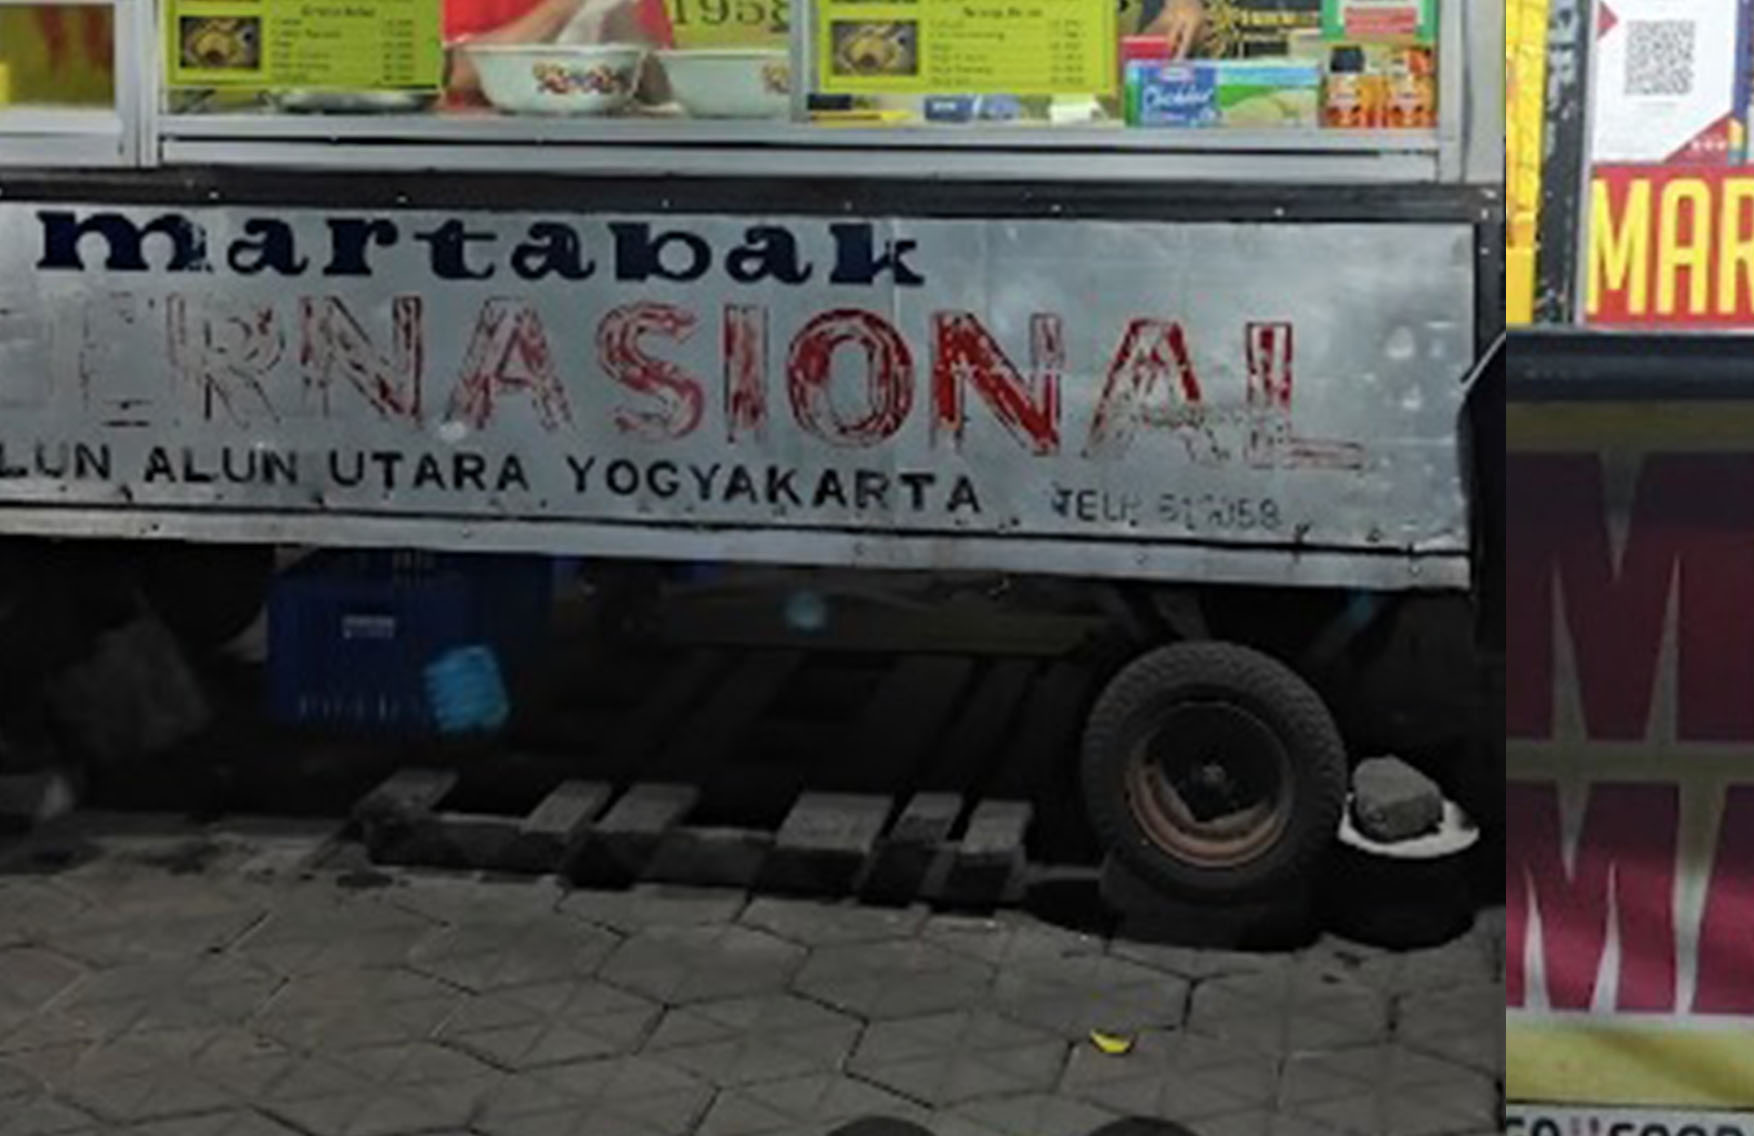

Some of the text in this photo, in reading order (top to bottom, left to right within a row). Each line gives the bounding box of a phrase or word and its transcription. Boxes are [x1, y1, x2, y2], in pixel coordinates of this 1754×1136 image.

[37, 211, 924, 286] martabak
[144, 446, 300, 485] ALUN
[329, 450, 530, 492] UTARA
[567, 456, 981, 514] YOGYAKARTA
